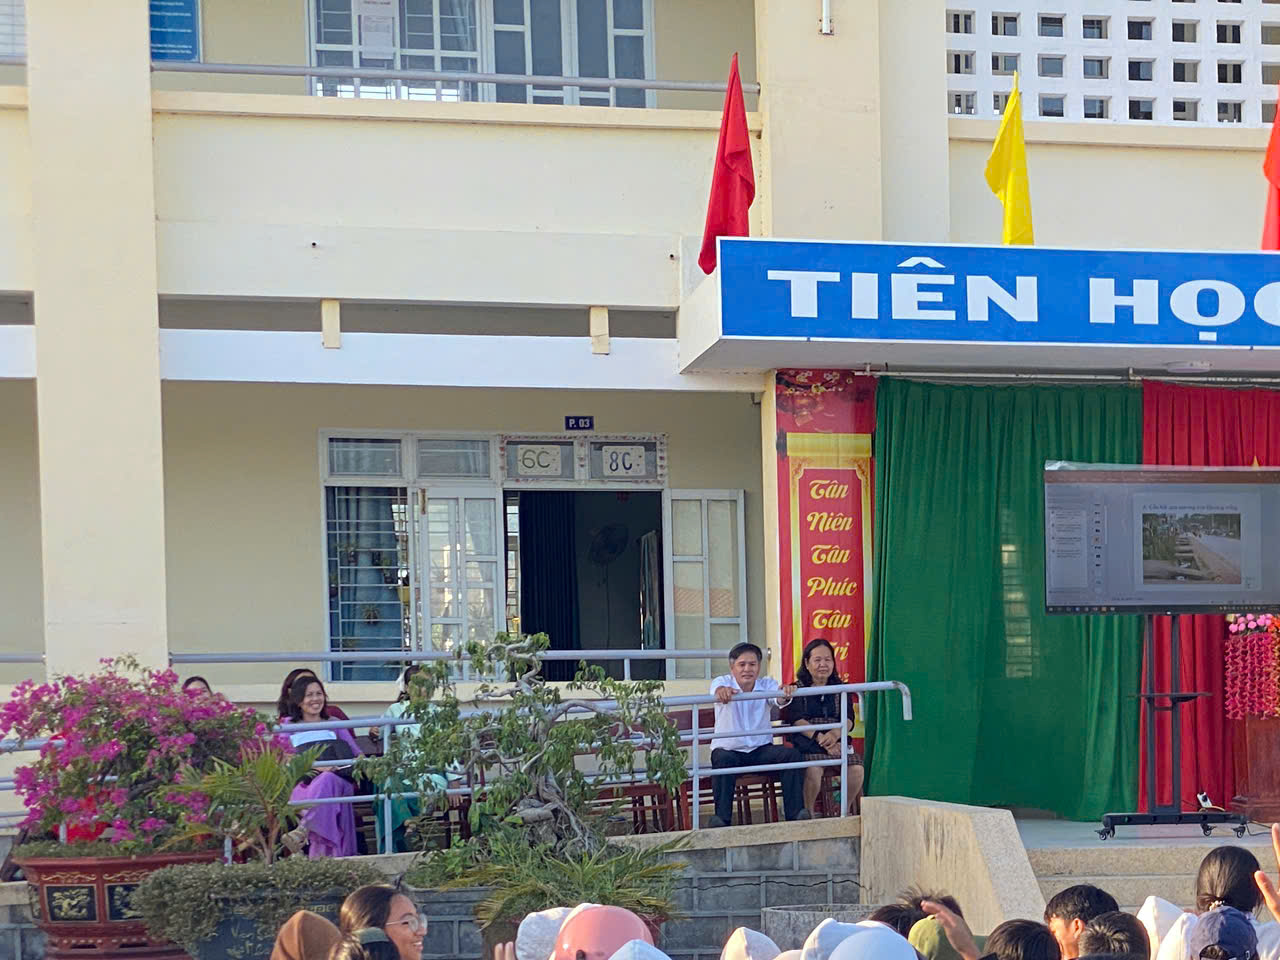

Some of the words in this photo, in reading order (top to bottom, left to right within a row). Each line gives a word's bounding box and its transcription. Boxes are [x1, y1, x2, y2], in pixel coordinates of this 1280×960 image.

[768, 256, 1038, 322] TIÊN
[579, 419, 590, 428] 03
[522, 450, 551, 469] 6C
[609, 451, 632, 472] 8C
[809, 480, 849, 500] Tân
[807, 512, 854, 533] Niên
[811, 544, 851, 565] Tân
[807, 576, 858, 598] Phúc
[812, 609, 852, 629] Tân
